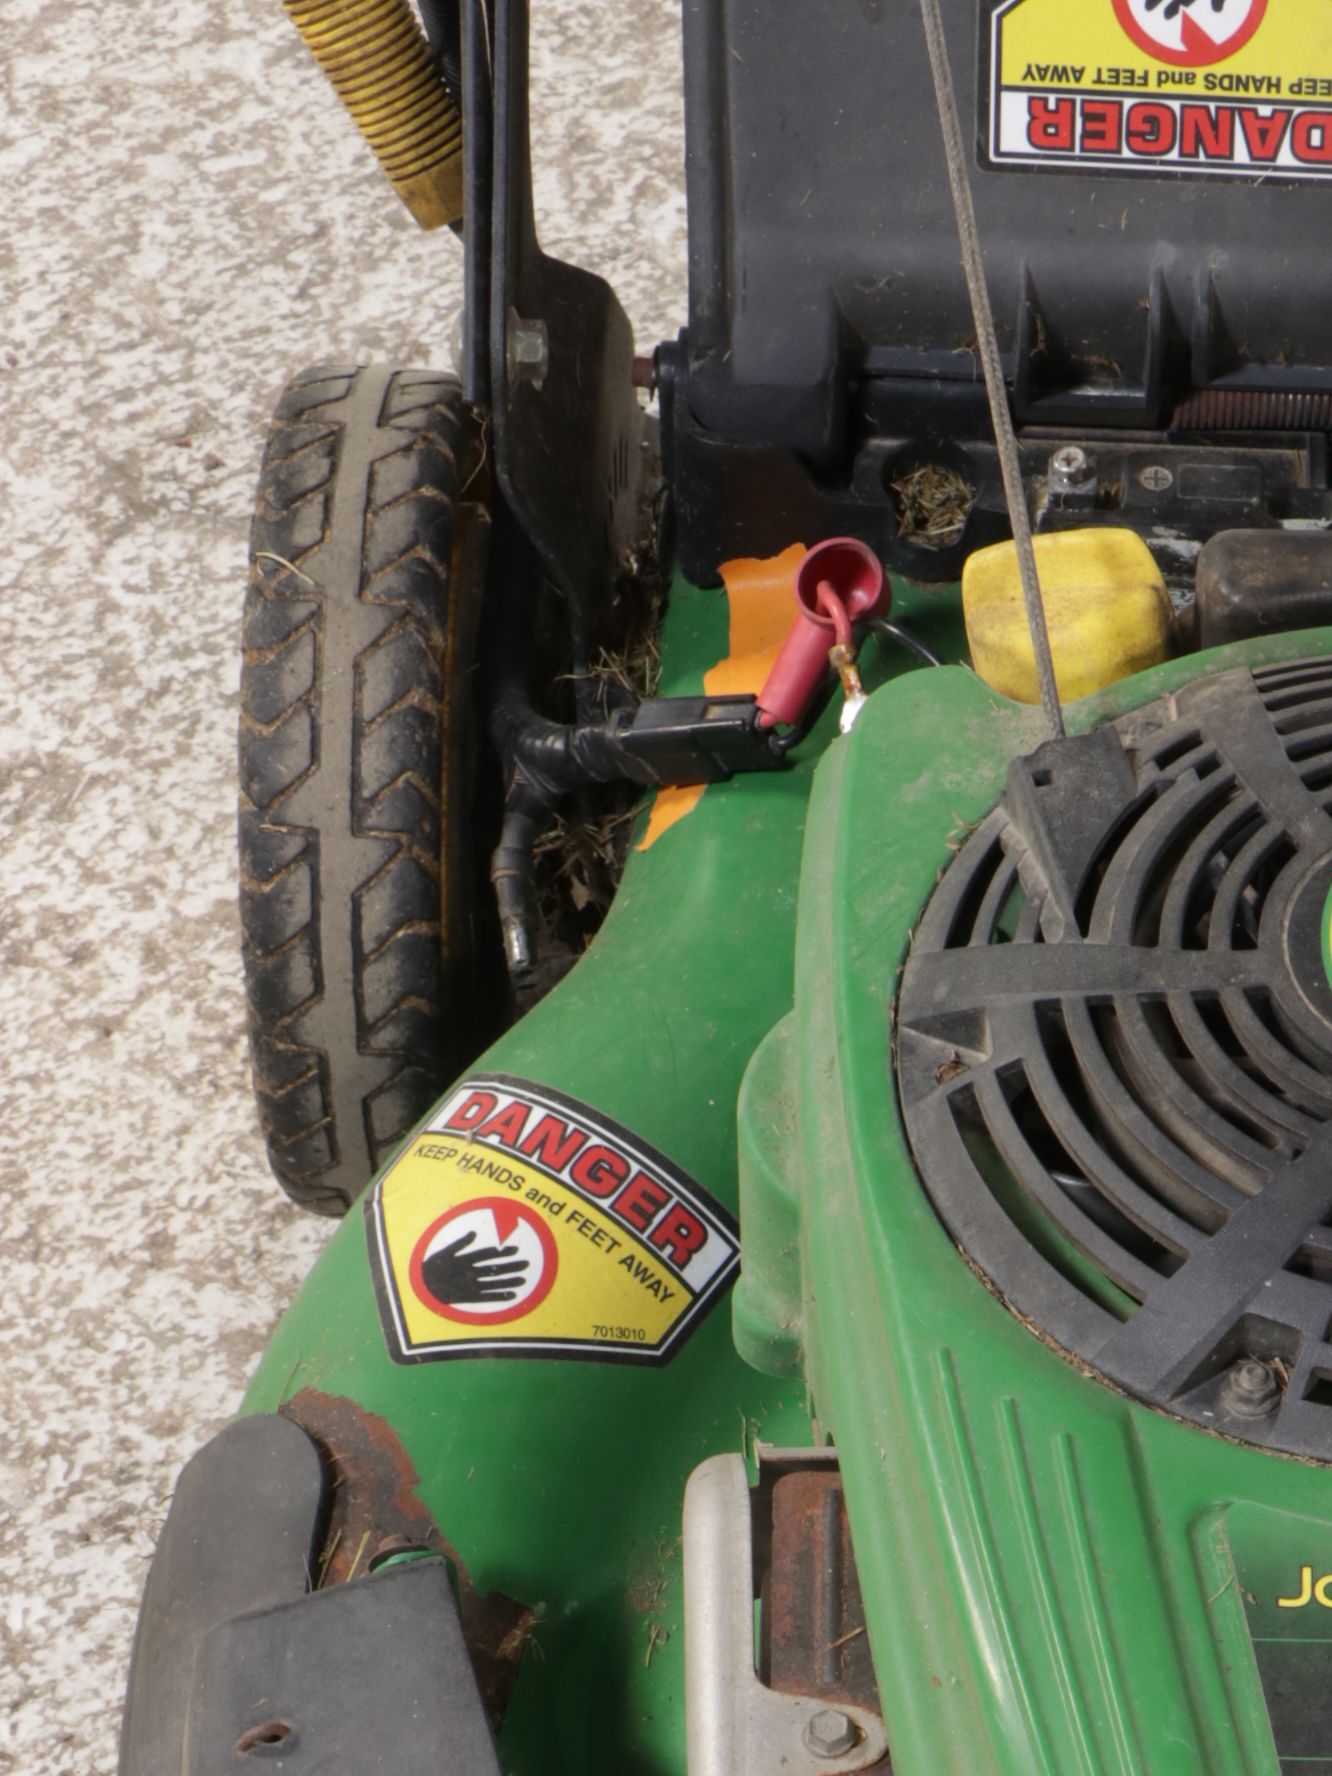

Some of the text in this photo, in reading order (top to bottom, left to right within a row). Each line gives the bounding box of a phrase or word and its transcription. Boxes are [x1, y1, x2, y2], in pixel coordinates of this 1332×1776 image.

[1021, 63, 1086, 83] AWAY
[1092, 67, 1149, 87] FEET
[1156, 71, 1196, 88] and
[1203, 74, 1282, 94] HANDS
[443, 1091, 709, 1272] DANGER
[413, 1143, 675, 1305] KEEP HANDS and FEET AWAY
[592, 1324, 646, 1341] 7013010
